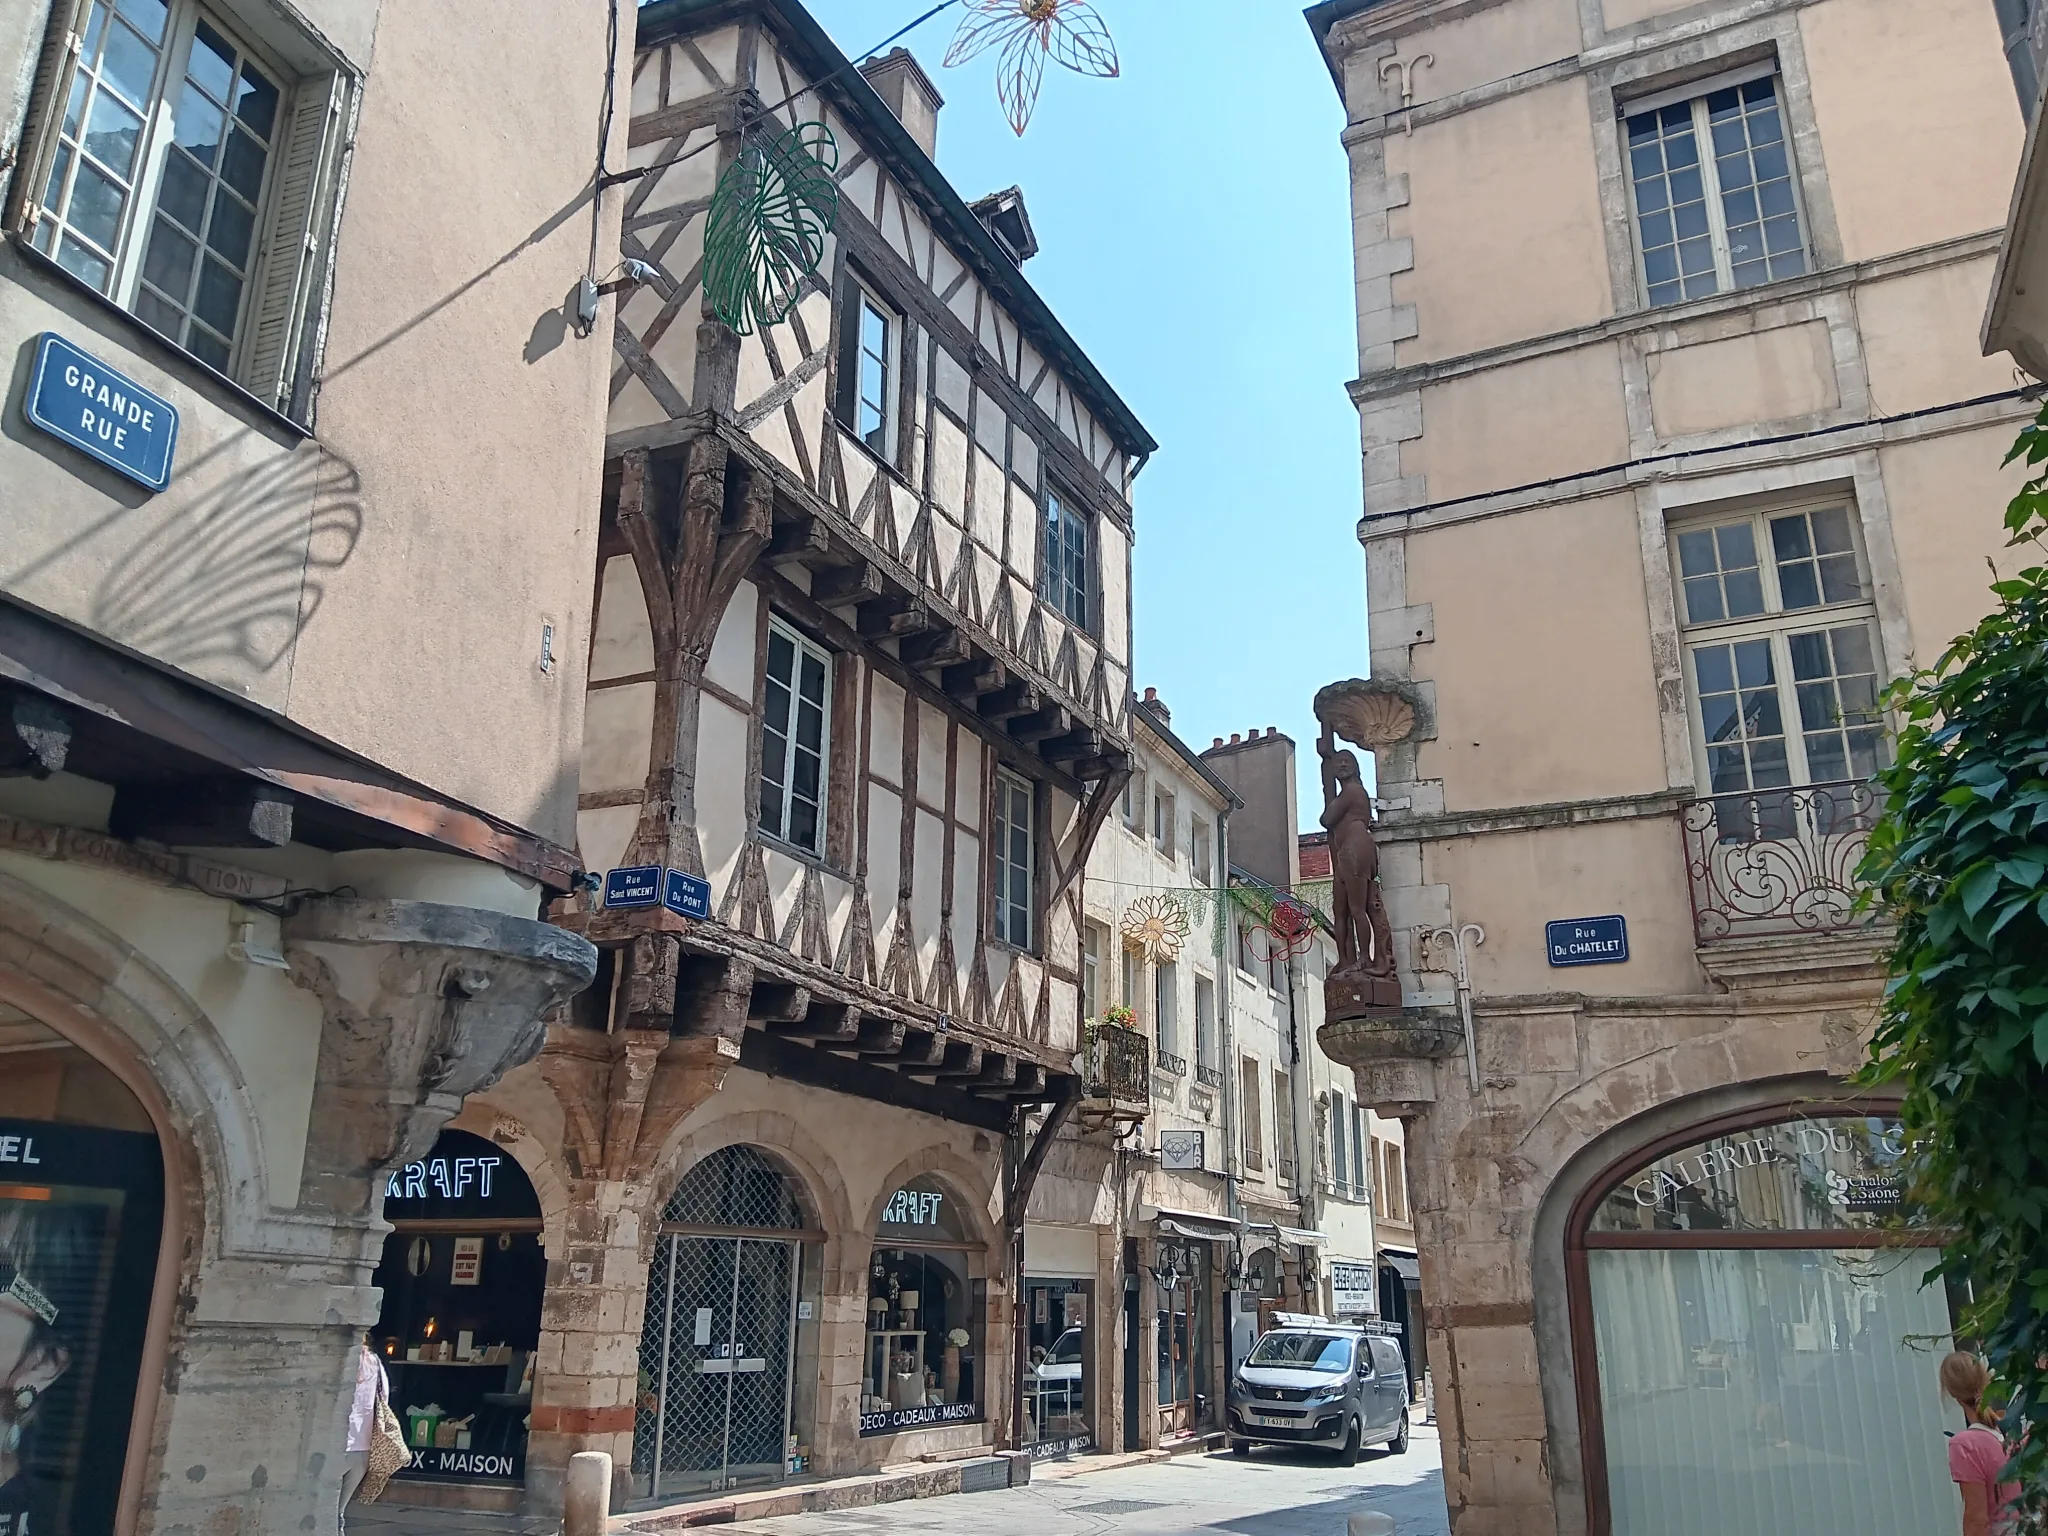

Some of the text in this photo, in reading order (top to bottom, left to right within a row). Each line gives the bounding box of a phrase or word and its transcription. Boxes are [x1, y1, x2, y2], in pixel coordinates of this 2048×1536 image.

[65, 365, 154, 432] GRANDE
[81, 408, 128, 450] RUE
[626, 876, 640, 884] Rue
[682, 881, 695, 893] Rue
[610, 887, 654, 899] Saint VINCENT
[683, 895, 701, 909] PONT
[1575, 928, 1596, 938] Rue
[1555, 940, 1619, 955] Du CHATELET
[0, 1136, 40, 1164] EL
[1193, 1132, 1202, 1168] BAR
[1634, 1136, 1778, 1207] GALERIE
[1798, 1127, 1854, 1155] DU
[883, 1190, 942, 1225] KRAFT
[860, 1413, 886, 1430] DECO
[893, 1407, 936, 1426] CADEAUX
[943, 1403, 976, 1420] MAISON
[1036, 1440, 1065, 1457] CADEAUX
[1069, 1434, 1091, 1450] MAISON
[440, 1452, 513, 1475] MAISON
